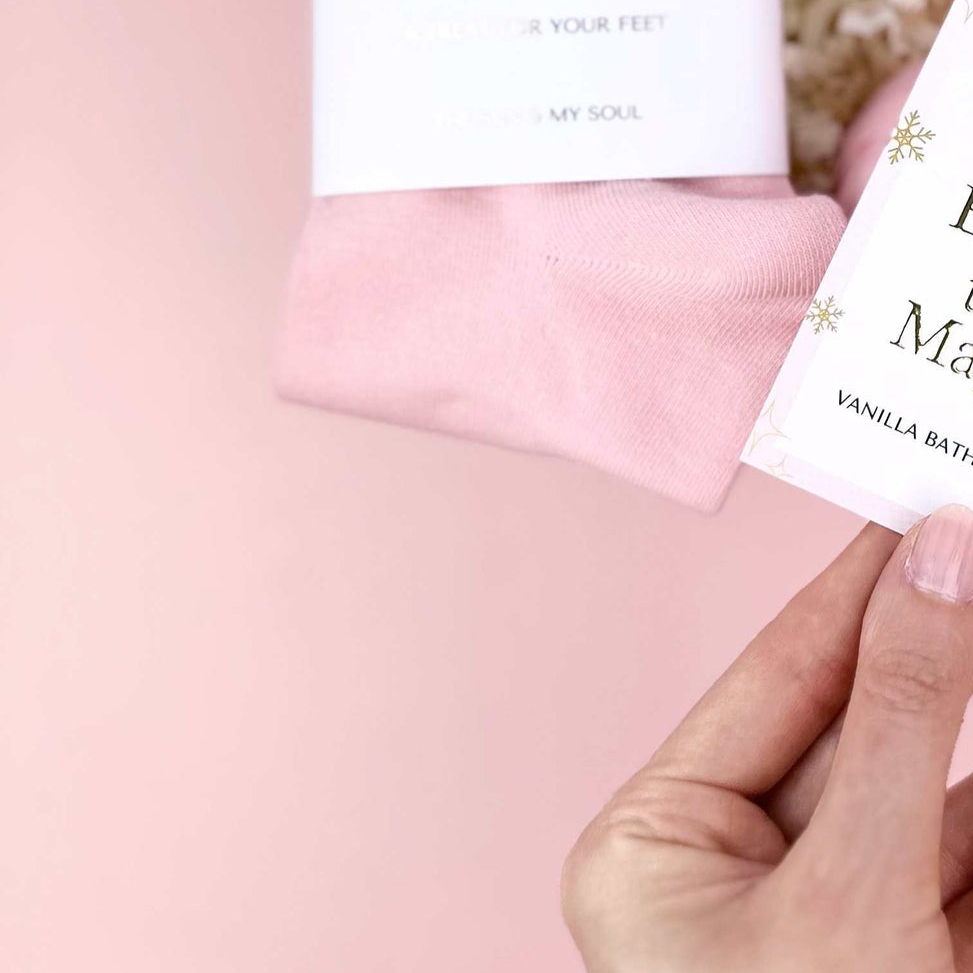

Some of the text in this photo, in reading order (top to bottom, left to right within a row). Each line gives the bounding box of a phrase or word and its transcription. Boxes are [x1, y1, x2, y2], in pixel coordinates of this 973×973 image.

[550, 15, 612, 36] YOUR
[617, 13, 669, 34] FEET
[549, 105, 582, 124] MY
[586, 103, 645, 123] SOUL
[837, 389, 919, 441] VANILLA
